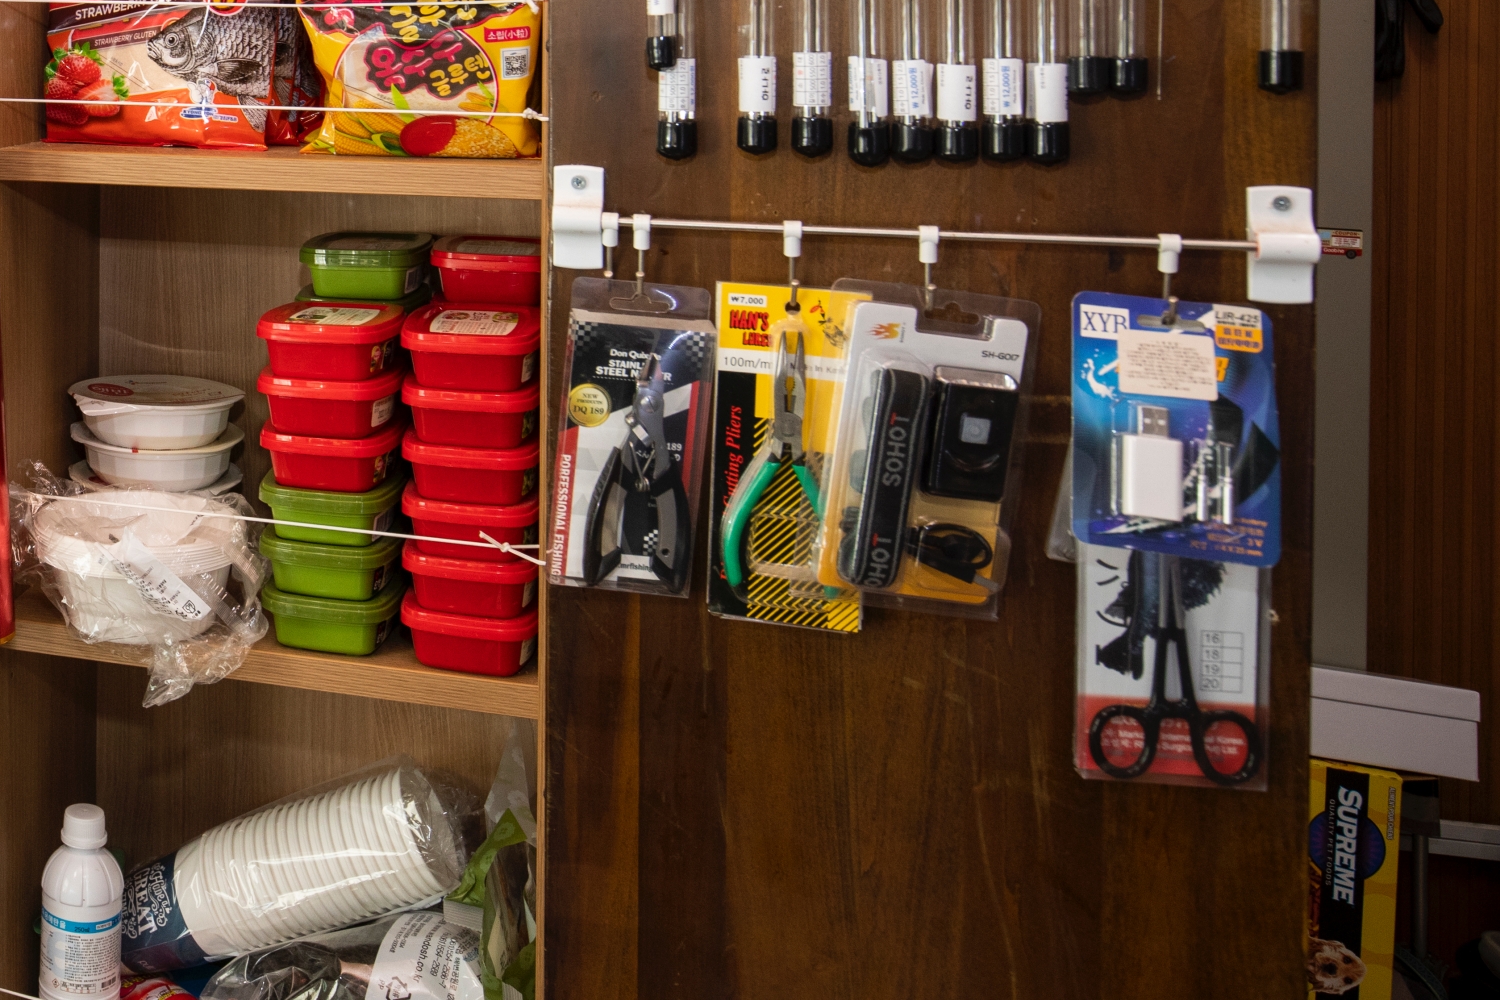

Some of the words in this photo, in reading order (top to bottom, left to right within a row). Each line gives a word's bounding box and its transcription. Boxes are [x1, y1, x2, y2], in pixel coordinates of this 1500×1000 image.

[94, 34, 133, 48] STRAWBERRY
[133, 29, 157, 40] GLUTEN
[428, 53, 491, 98] 글루텐
[908, 67, 918, 99] 12,000원
[1001, 65, 1011, 97] 12,000원
[610, 349, 628, 358] Don
[595, 366, 629, 378] STEEL
[573, 406, 590, 416] DQ
[591, 406, 605, 415] 189
[726, 406, 742, 448] Pliers
[554, 454, 571, 533] PORFESSIONAL
[550, 534, 565, 582] FISHING
[864, 534, 891, 587] OHOT
[1203, 679, 1220, 689] 20
[1327, 799, 1335, 836] QUALITY
[1332, 785, 1363, 906] SUPREME
[1325, 856, 1333, 886] FOODS
